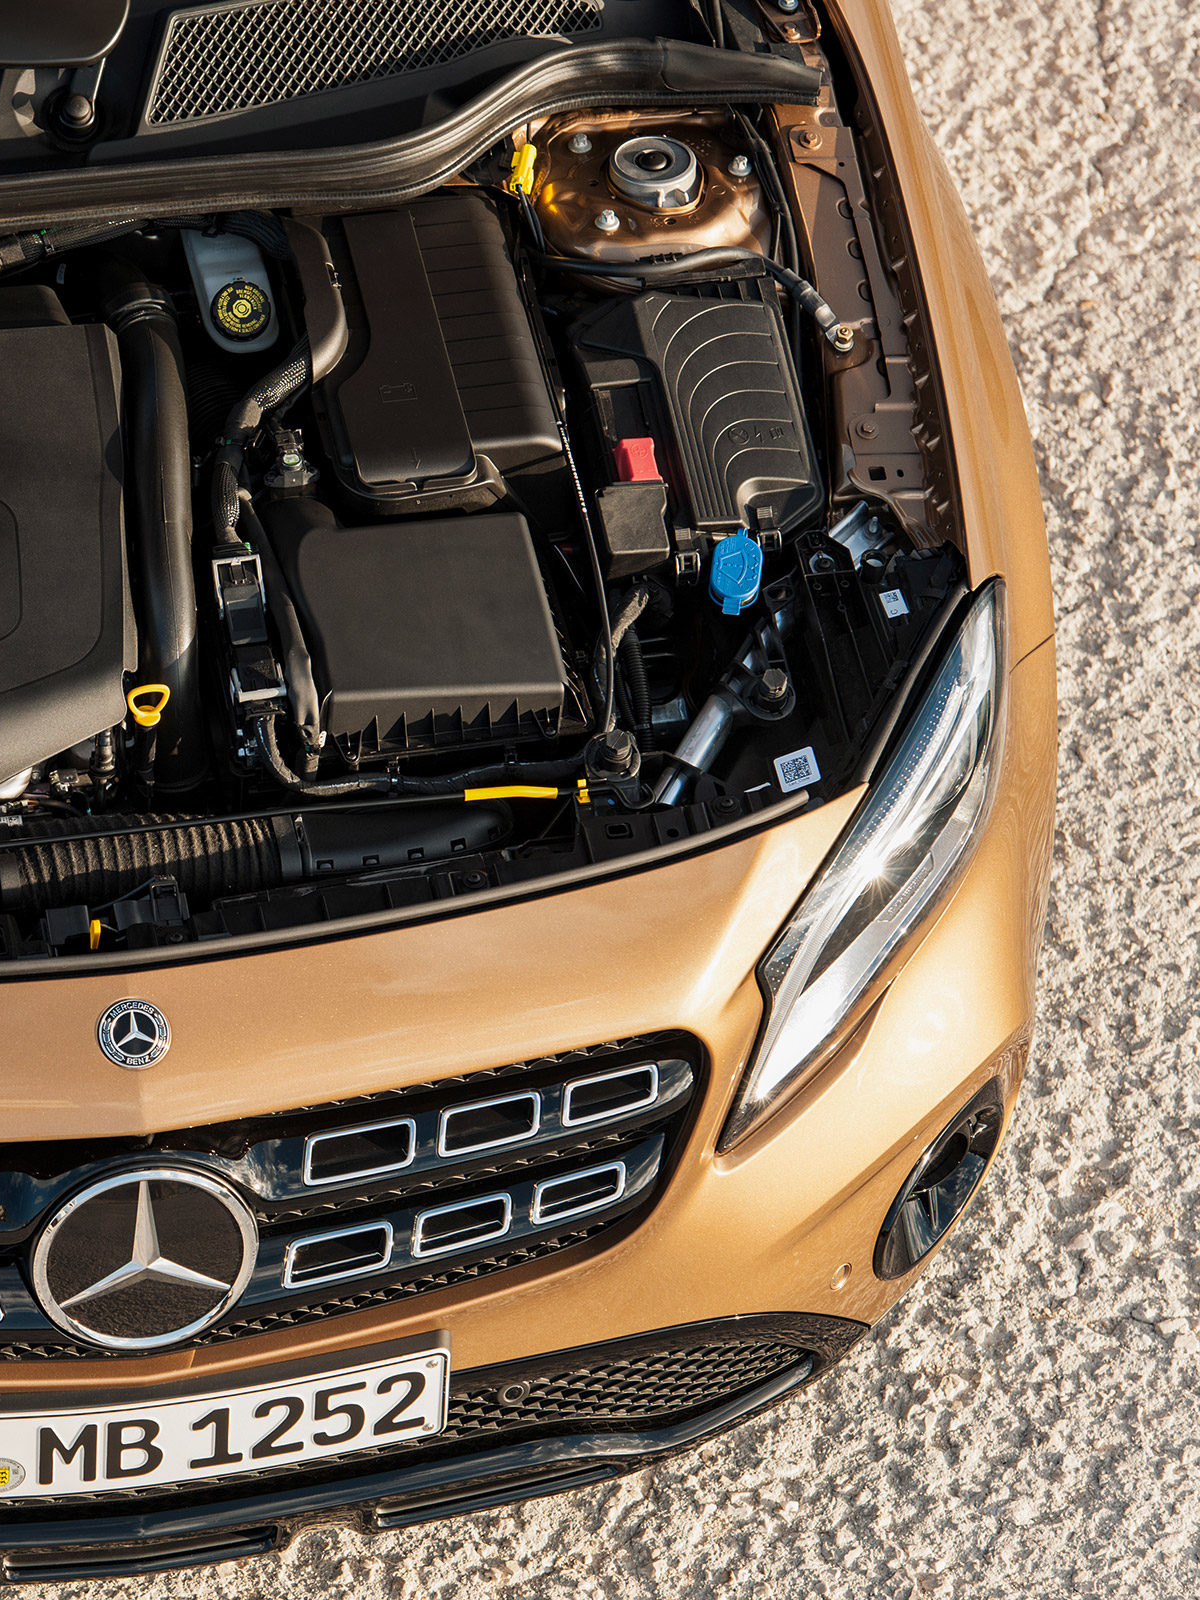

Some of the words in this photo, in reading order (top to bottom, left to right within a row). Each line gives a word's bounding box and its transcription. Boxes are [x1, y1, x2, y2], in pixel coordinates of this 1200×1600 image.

[109, 1002, 154, 1018] MERCEDES
[126, 1055, 151, 1066] BENZ
[39, 1418, 163, 1484] MB
[190, 1372, 426, 1469] 1252
